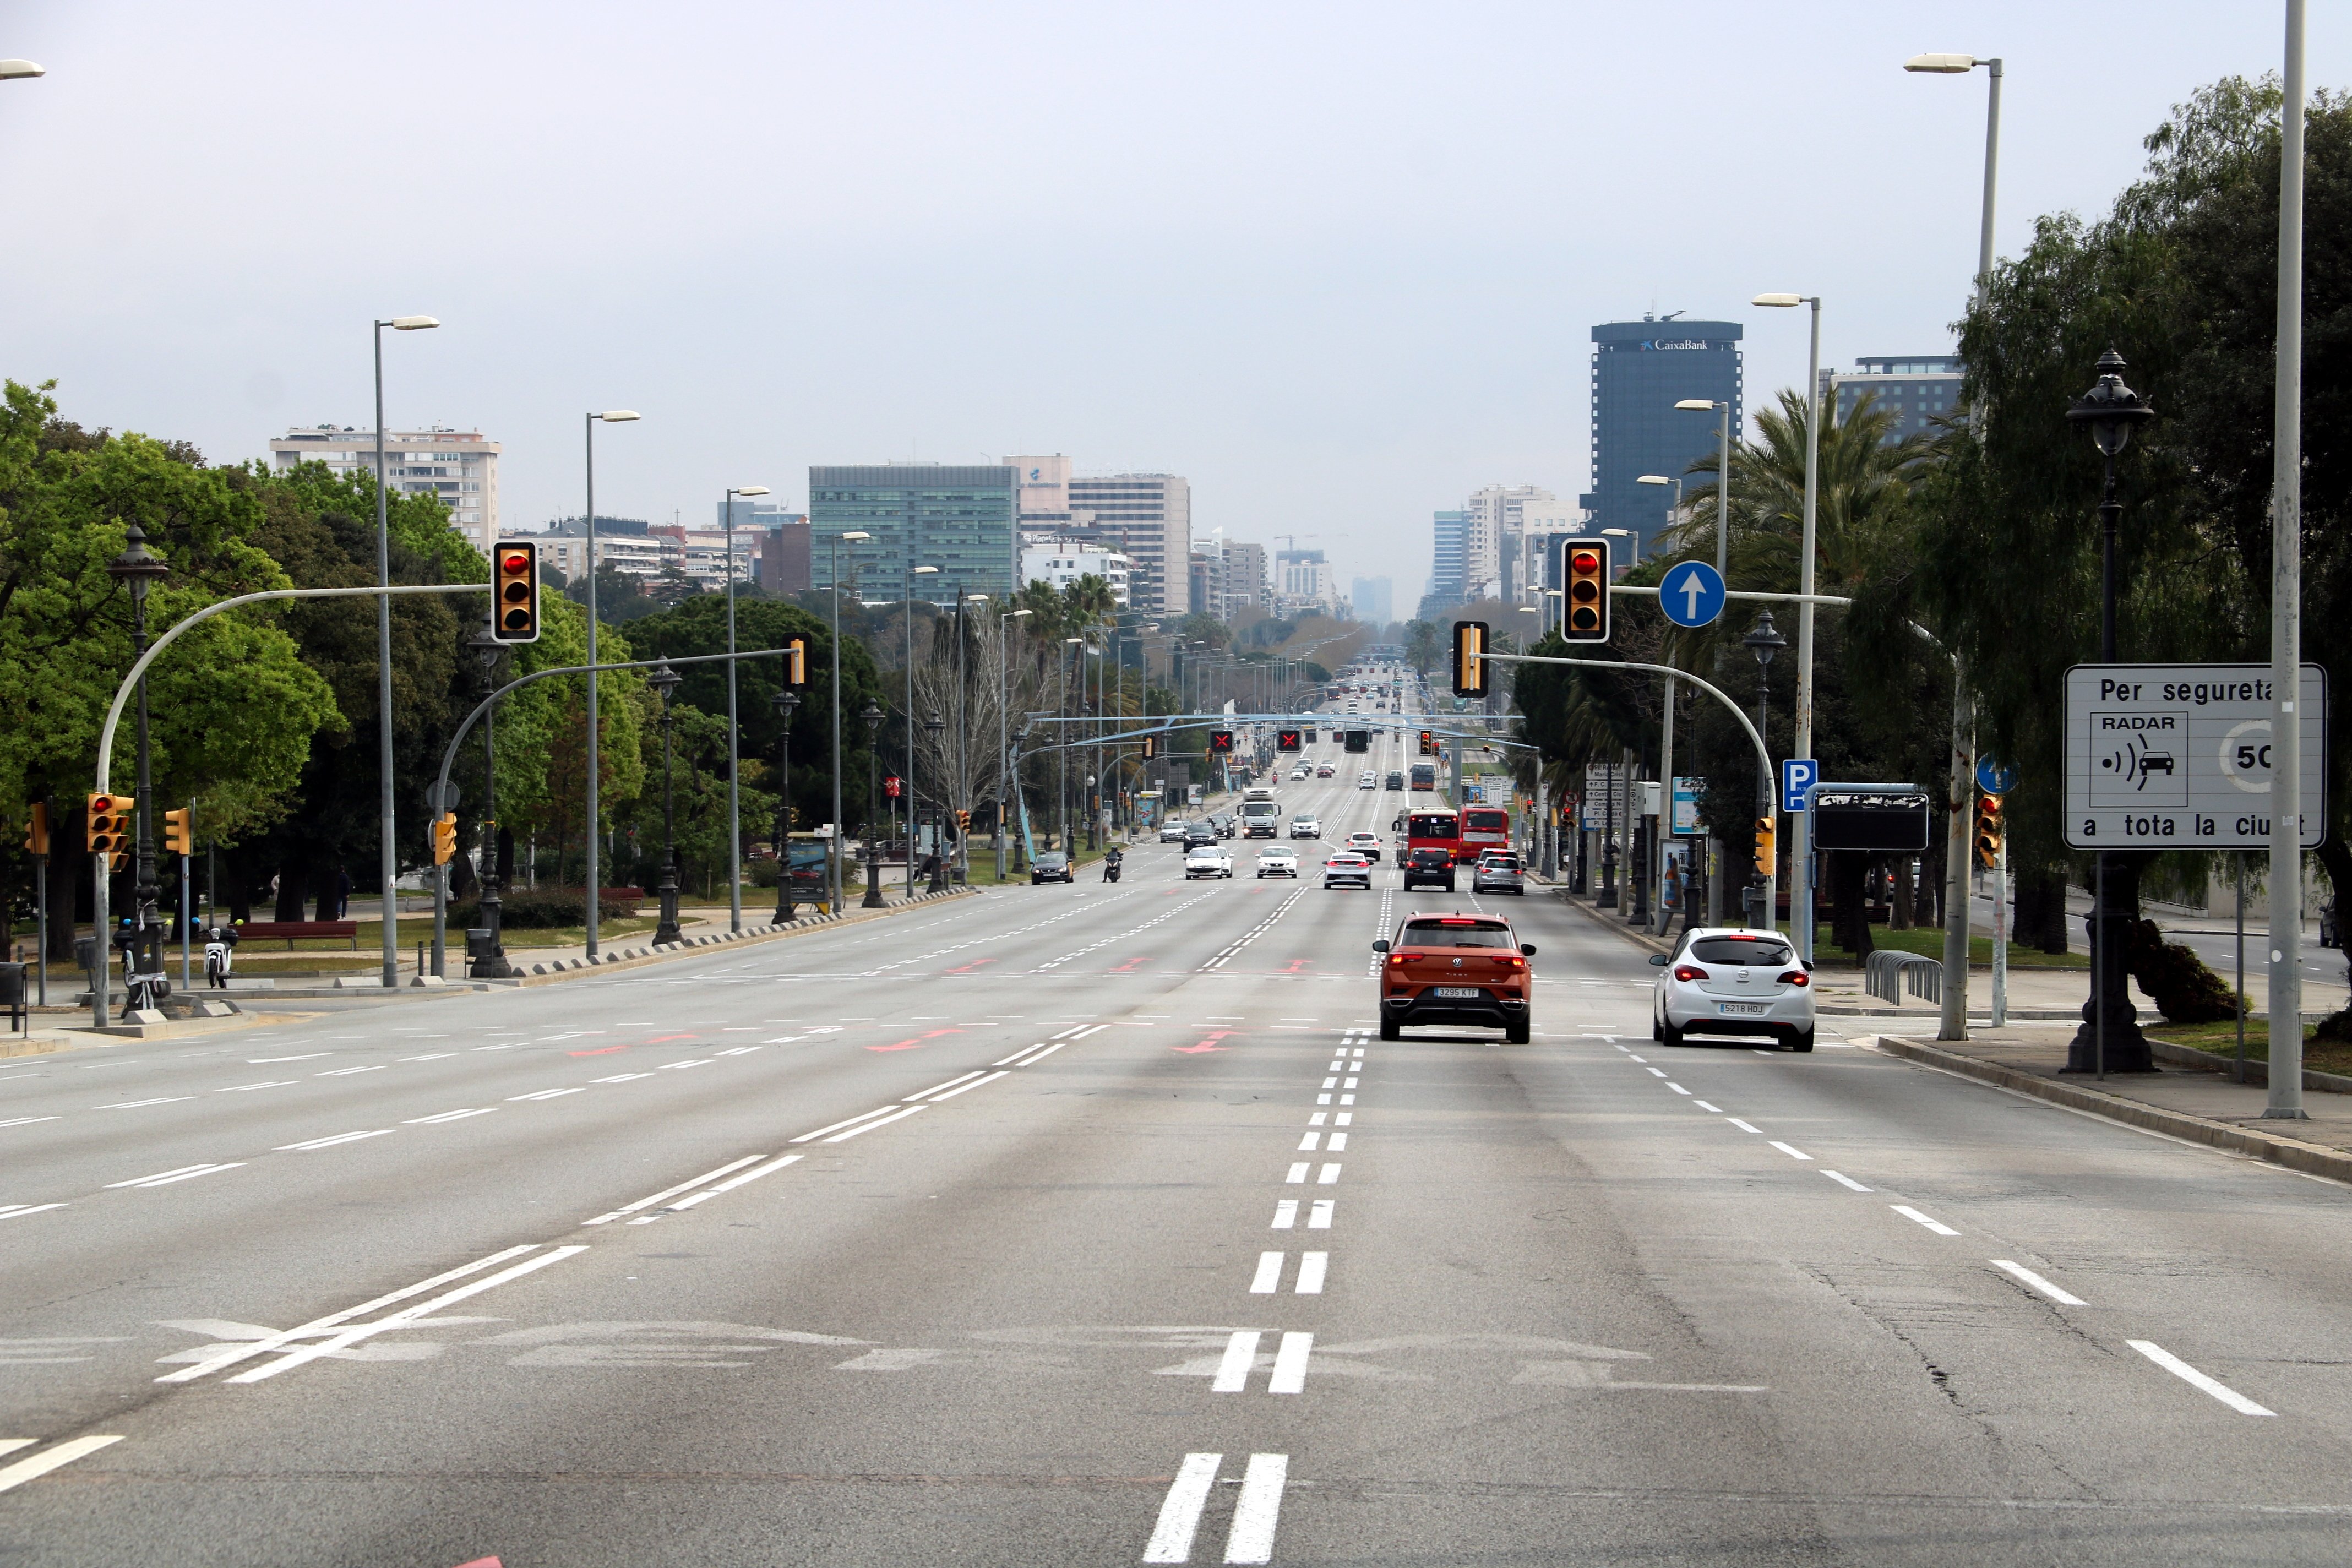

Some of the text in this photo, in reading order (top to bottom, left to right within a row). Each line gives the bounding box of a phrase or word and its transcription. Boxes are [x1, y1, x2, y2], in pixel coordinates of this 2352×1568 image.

[1654, 339, 1708, 350] CaixaBank
[2101, 679, 2142, 700] Per
[2102, 717, 2175, 730] RADAR
[1790, 765, 1810, 791] P
[2083, 819, 2096, 836] a
[2125, 815, 2174, 836] tota
[2195, 813, 2215, 836] la
[1725, 1004, 1763, 1014] 5218 HDJ
